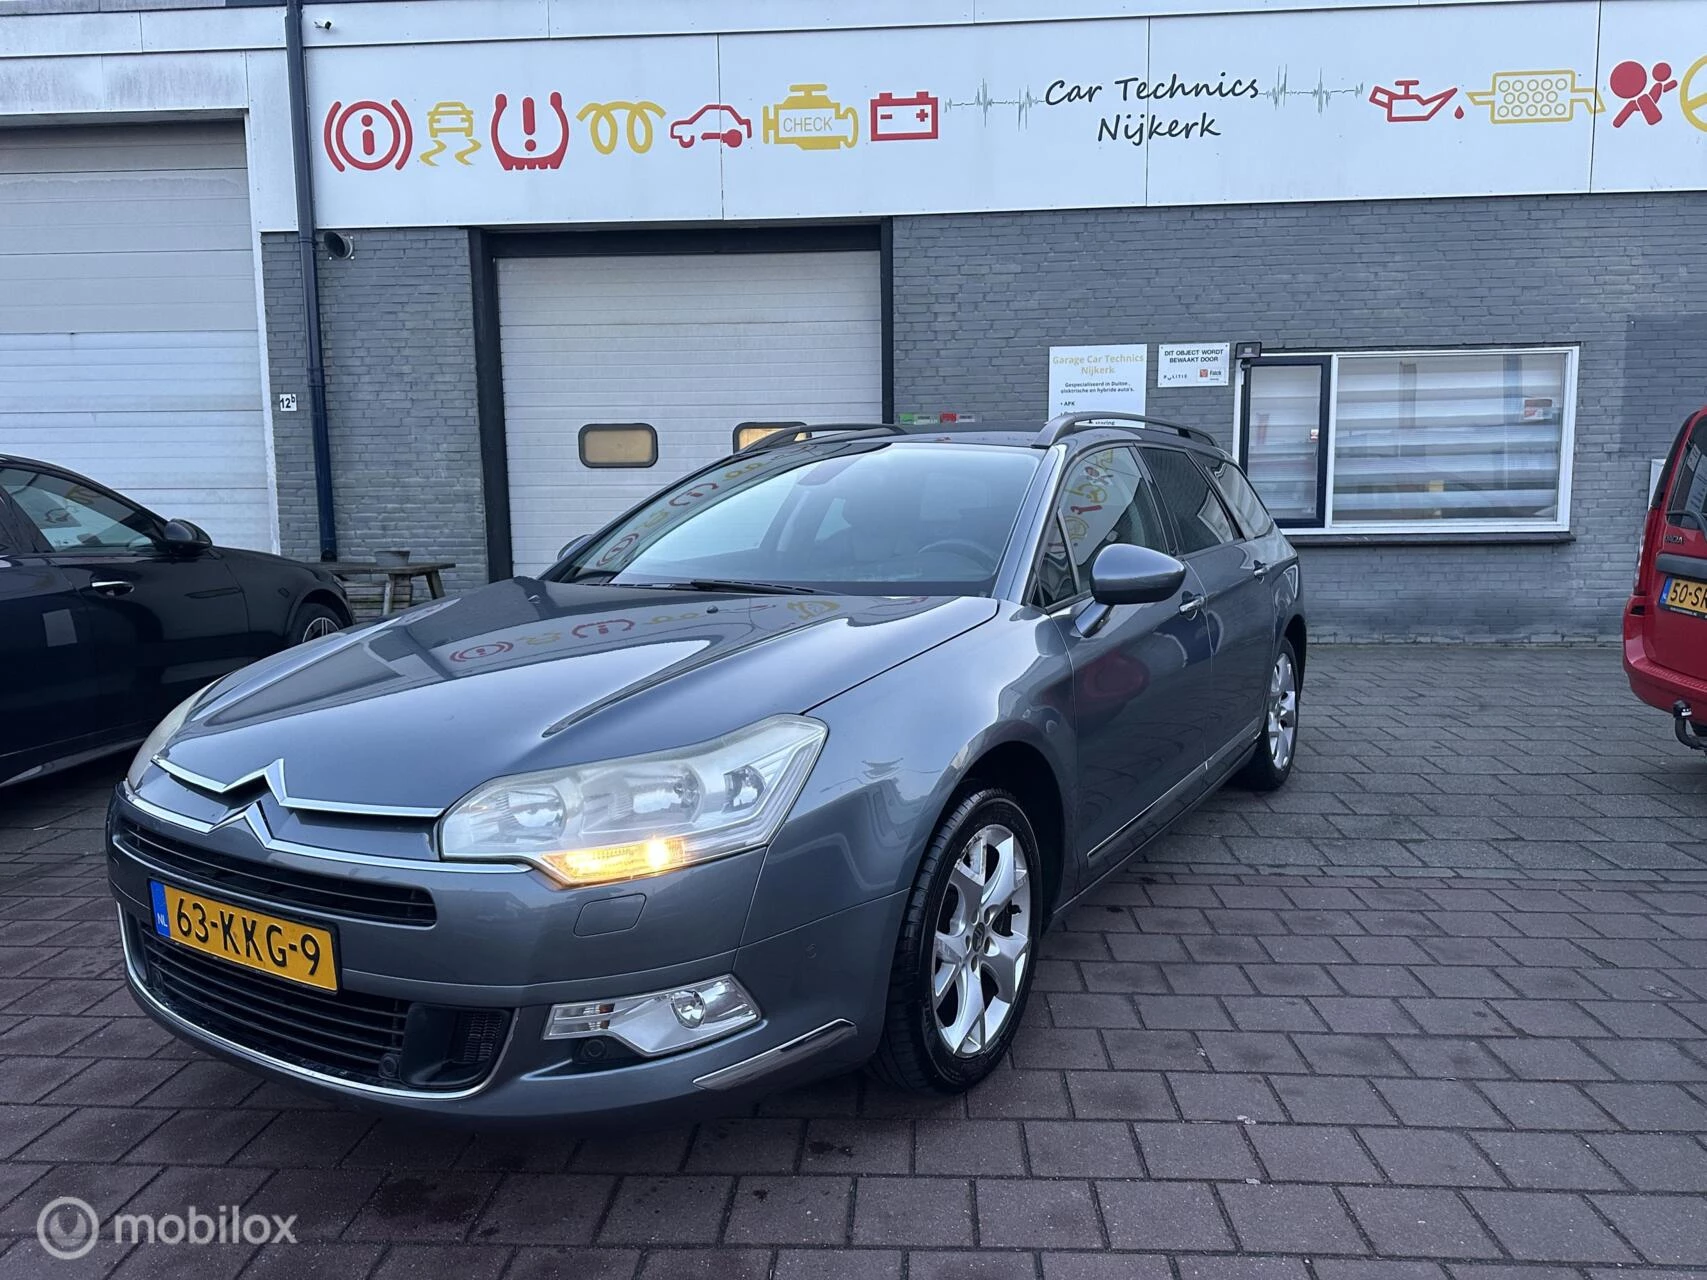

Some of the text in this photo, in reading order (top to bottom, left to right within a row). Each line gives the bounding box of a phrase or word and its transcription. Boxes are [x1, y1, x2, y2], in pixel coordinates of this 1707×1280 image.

[1045, 71, 1259, 106] Car Technics
[783, 116, 833, 132] CHECK
[1097, 112, 1221, 147] Nijkerk
[1052, 353, 1144, 366] Garage Car Technics
[1081, 366, 1115, 376] Nijkerk
[157, 912, 168, 928] NL
[176, 898, 321, 976] 63-KKG-9
